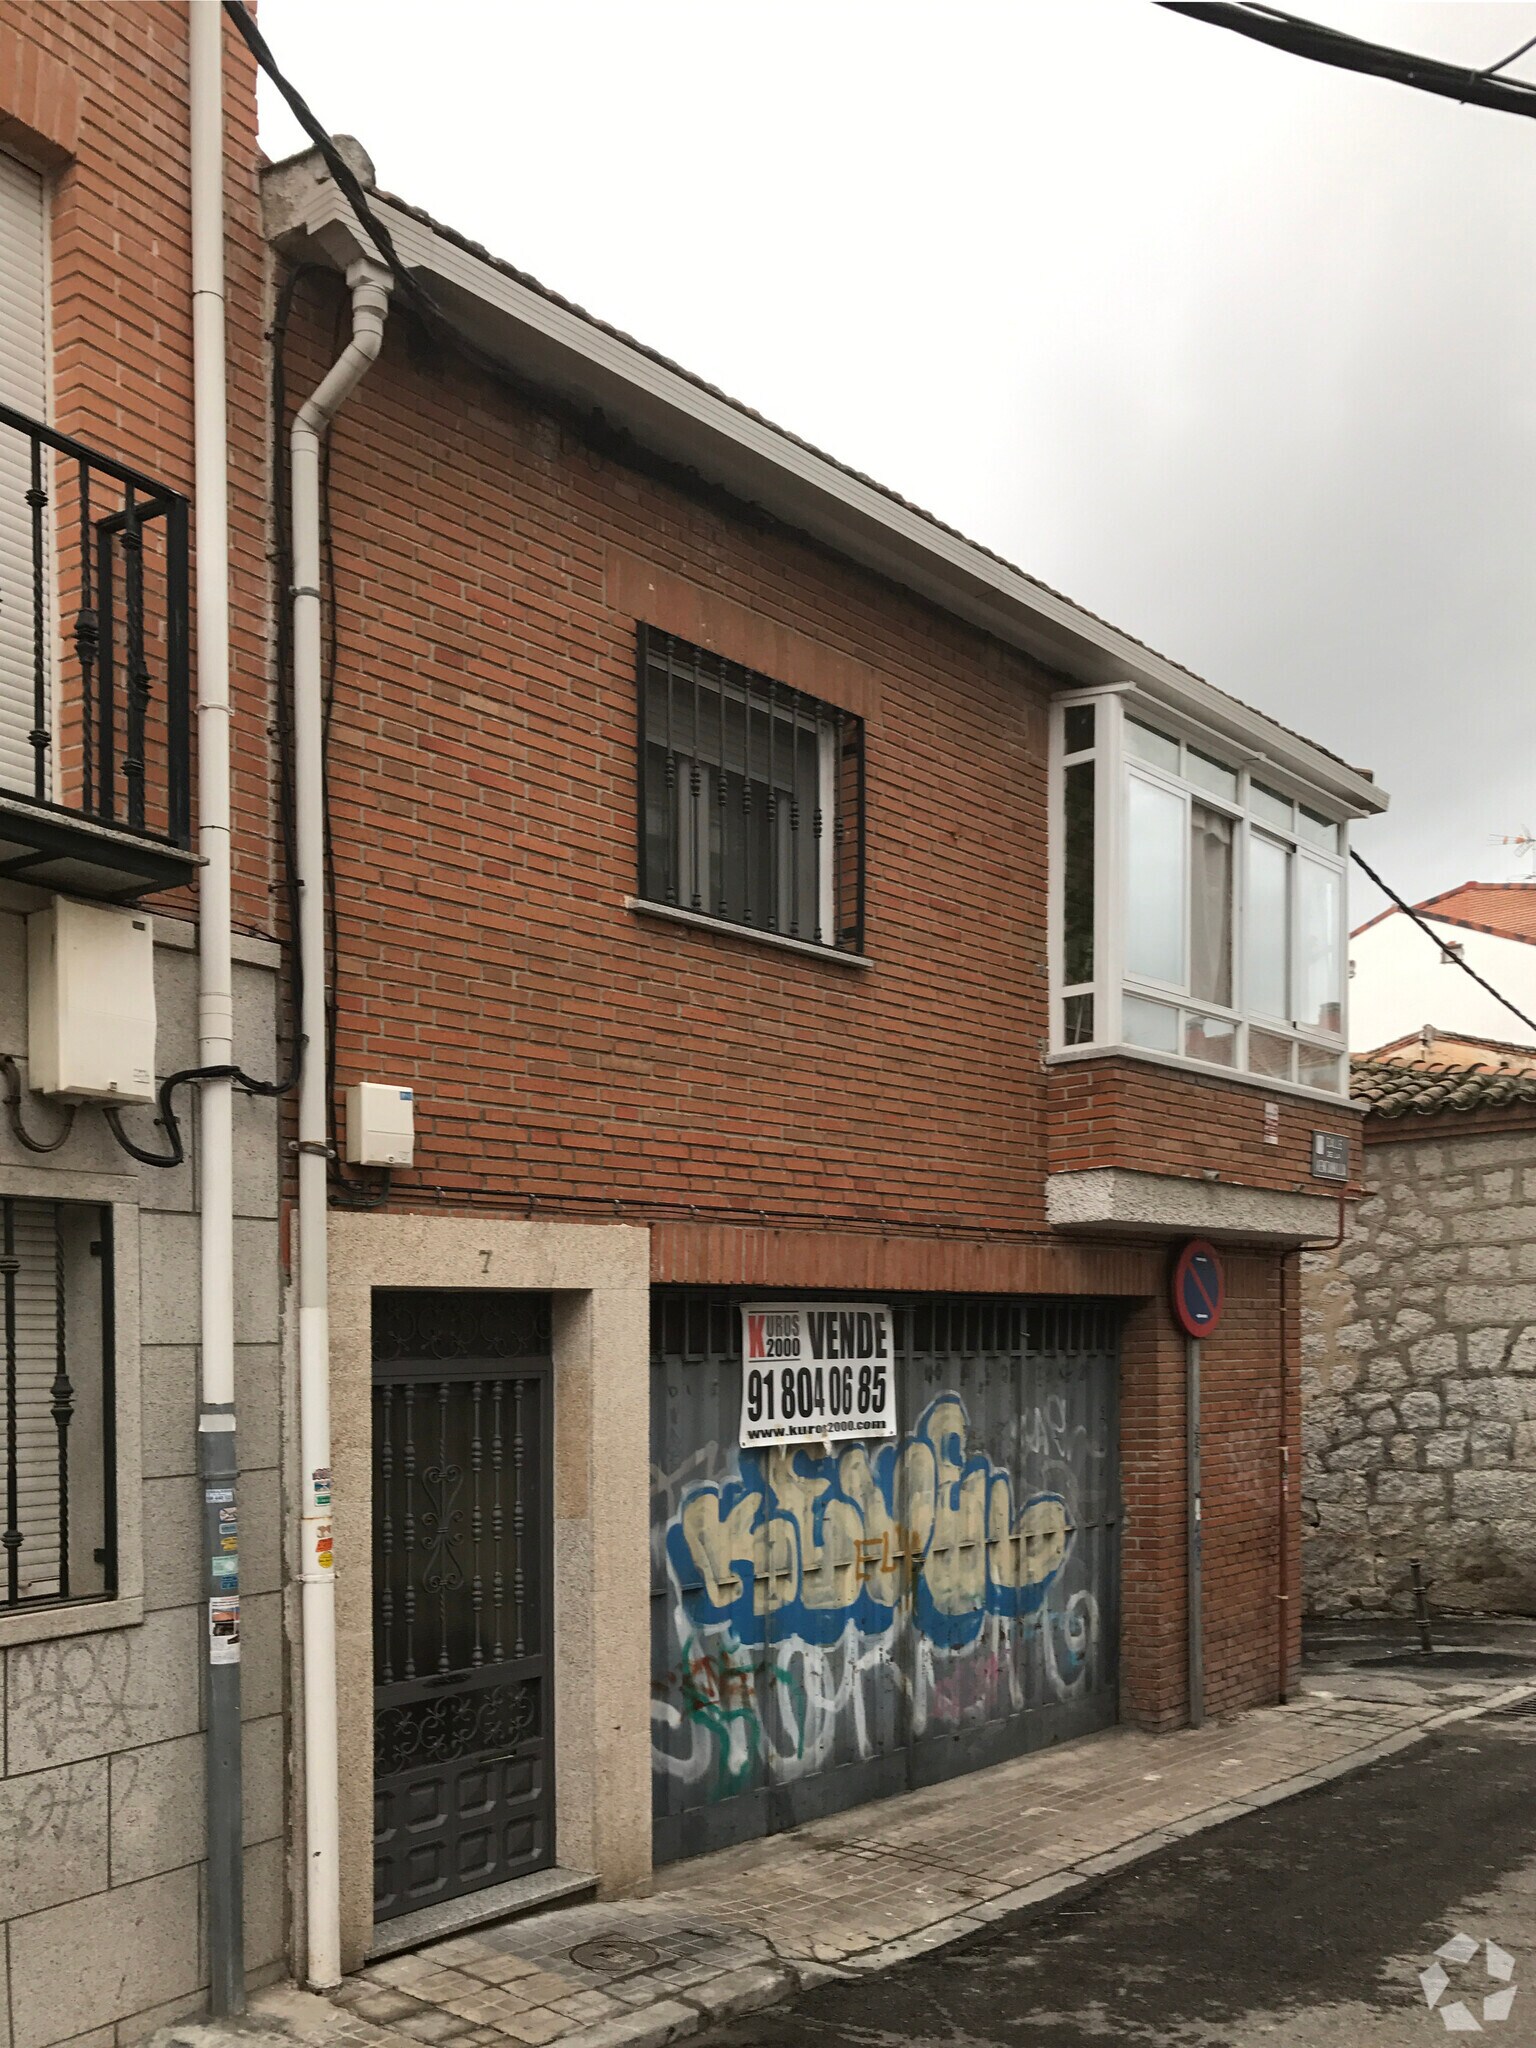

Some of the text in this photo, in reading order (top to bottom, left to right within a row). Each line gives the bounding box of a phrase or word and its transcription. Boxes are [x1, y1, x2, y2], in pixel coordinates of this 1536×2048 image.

[479, 1249, 493, 1273] 7
[748, 1314, 800, 1358] KUROS
[766, 1338, 800, 1357] 2000
[806, 1311, 888, 1360] VENDE
[748, 1364, 887, 1422] 91 804 06 85
